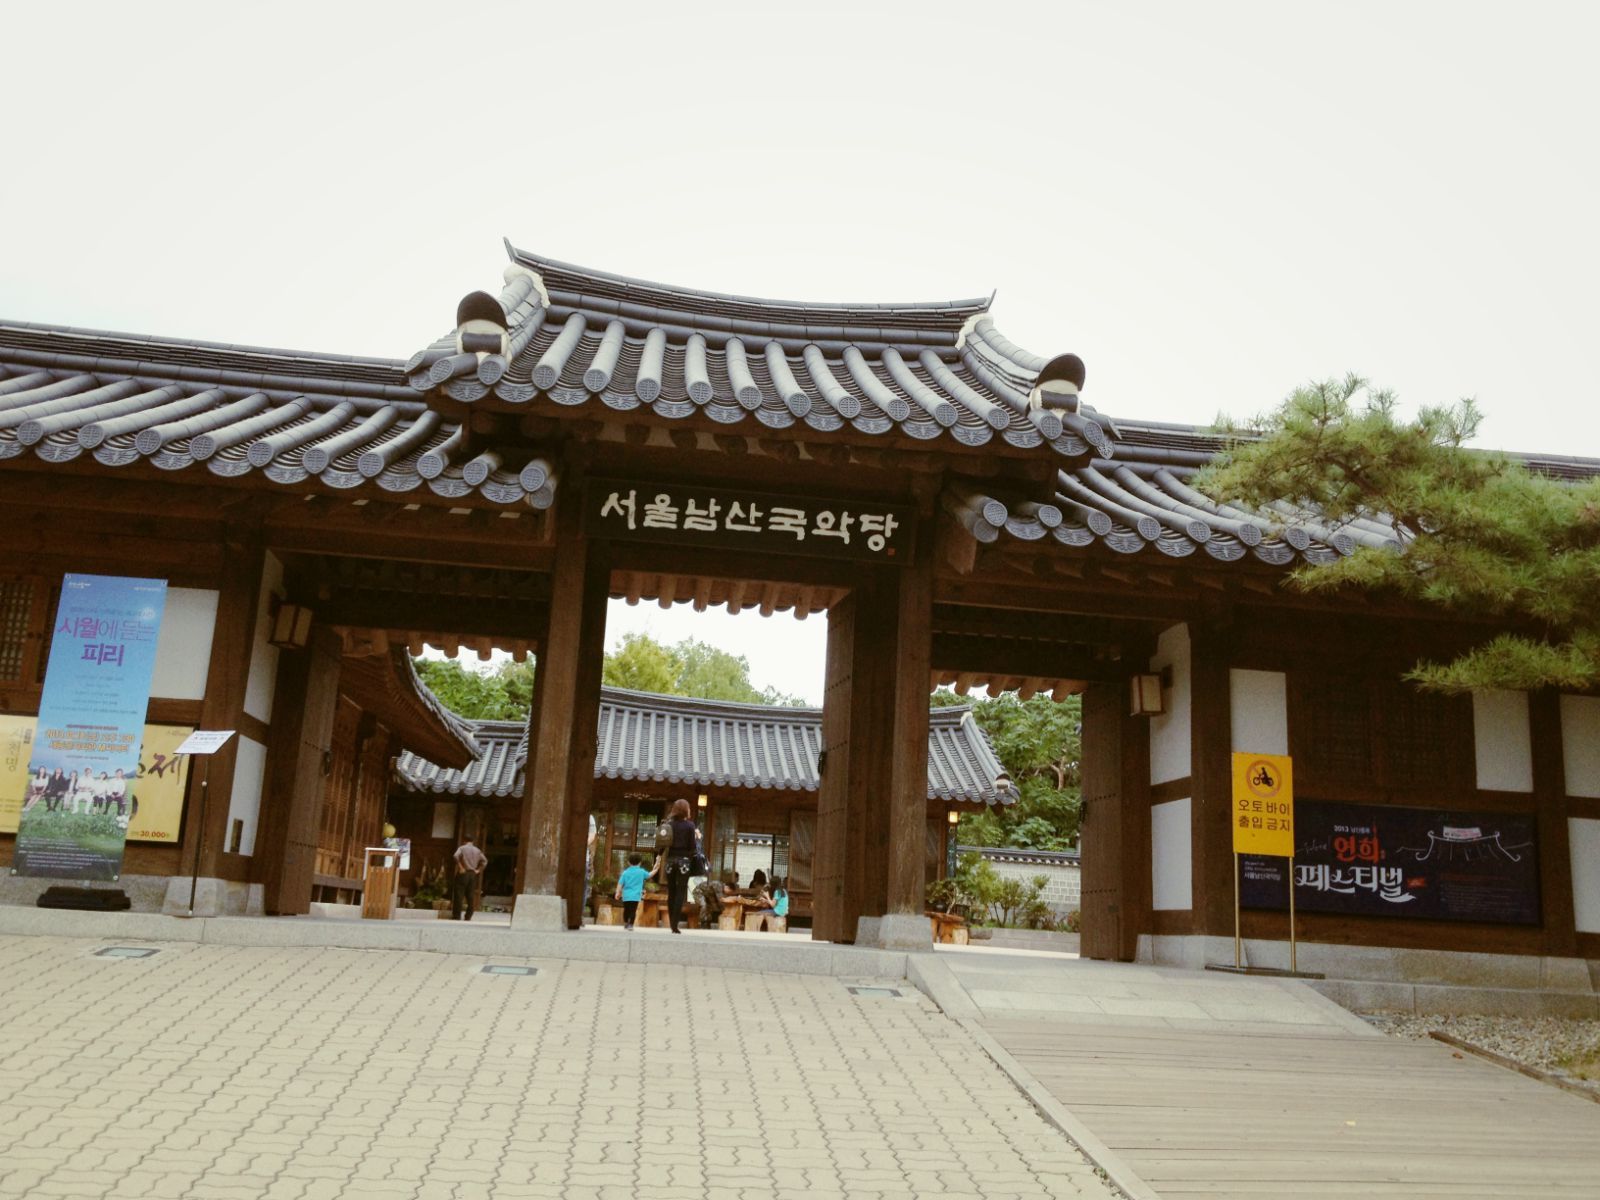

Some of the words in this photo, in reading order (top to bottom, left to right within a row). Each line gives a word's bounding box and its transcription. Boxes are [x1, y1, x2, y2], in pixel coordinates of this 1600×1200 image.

[600, 490, 899, 551] 서울남산국악당
[58, 617, 119, 641] 시월에
[120, 619, 156, 642] 듣는
[82, 644, 125, 667] 피리
[1239, 800, 1290, 816] 오토바이
[1239, 816, 1290, 832] 출입금지
[1333, 825, 1349, 833] 2013
[1334, 825, 1380, 864] 연희
[1295, 864, 1416, 903] 페스티벌
